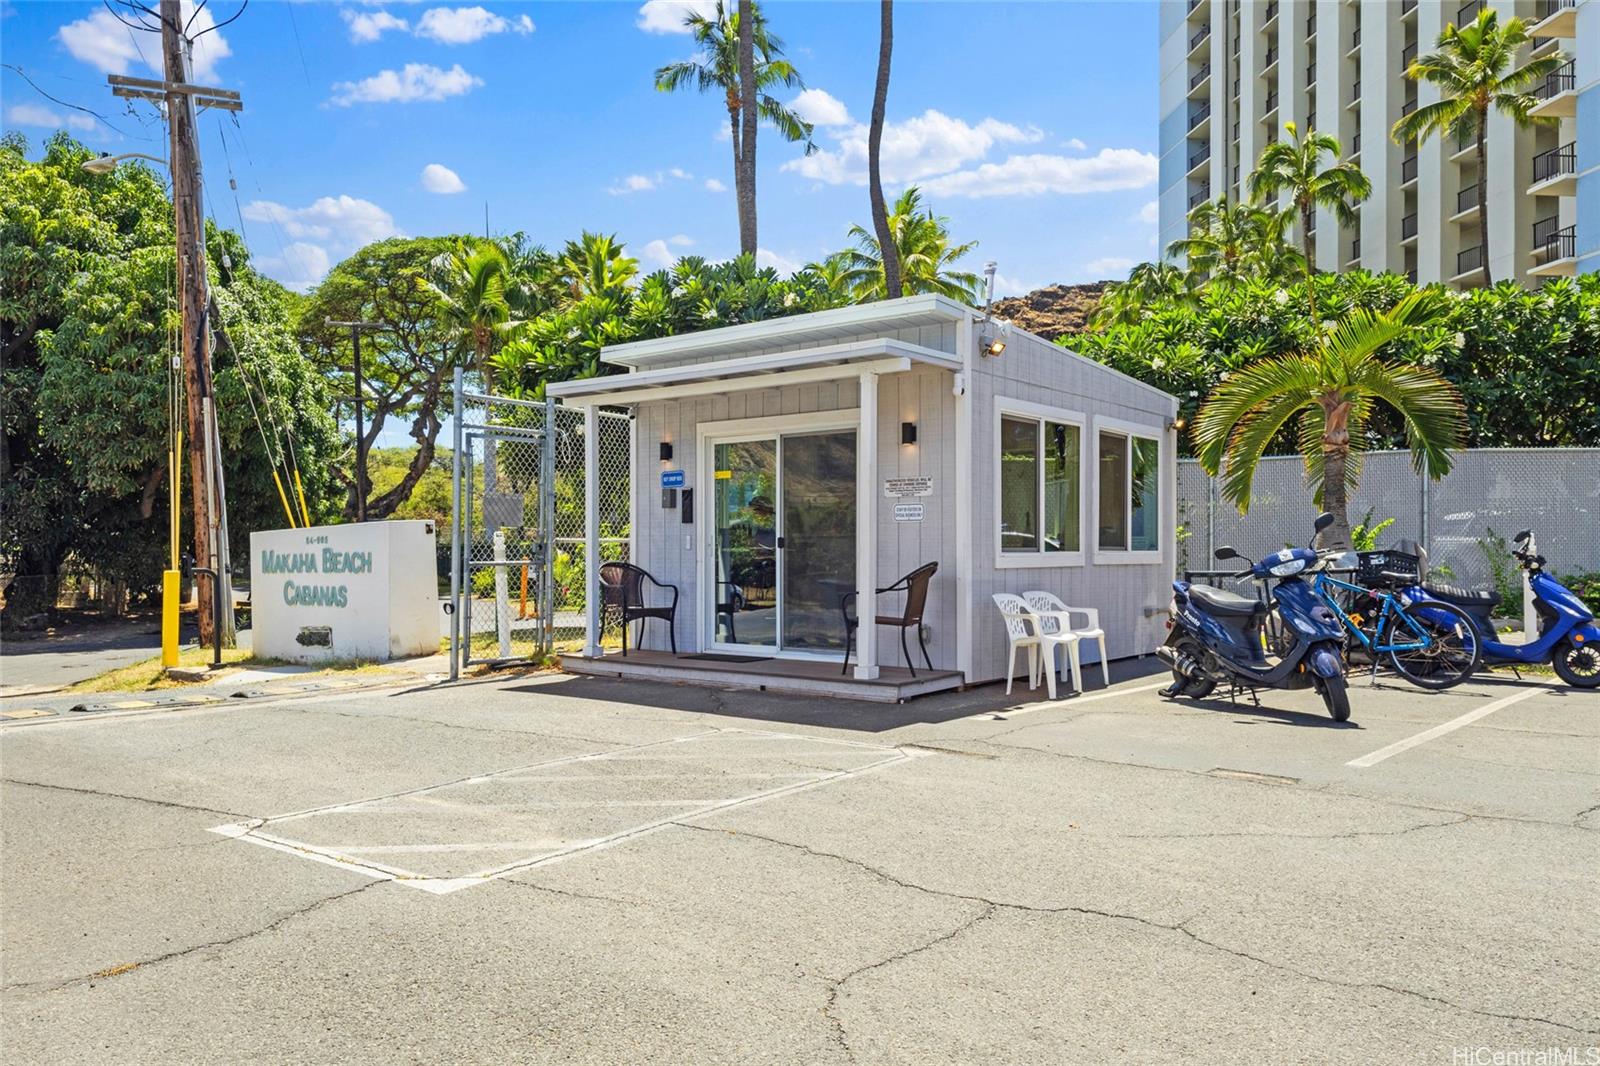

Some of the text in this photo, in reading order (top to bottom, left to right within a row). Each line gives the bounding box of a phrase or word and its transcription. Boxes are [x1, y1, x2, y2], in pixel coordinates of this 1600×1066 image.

[261, 547, 372, 574] MAKAHA BEACH
[283, 580, 348, 608] CABANAS
